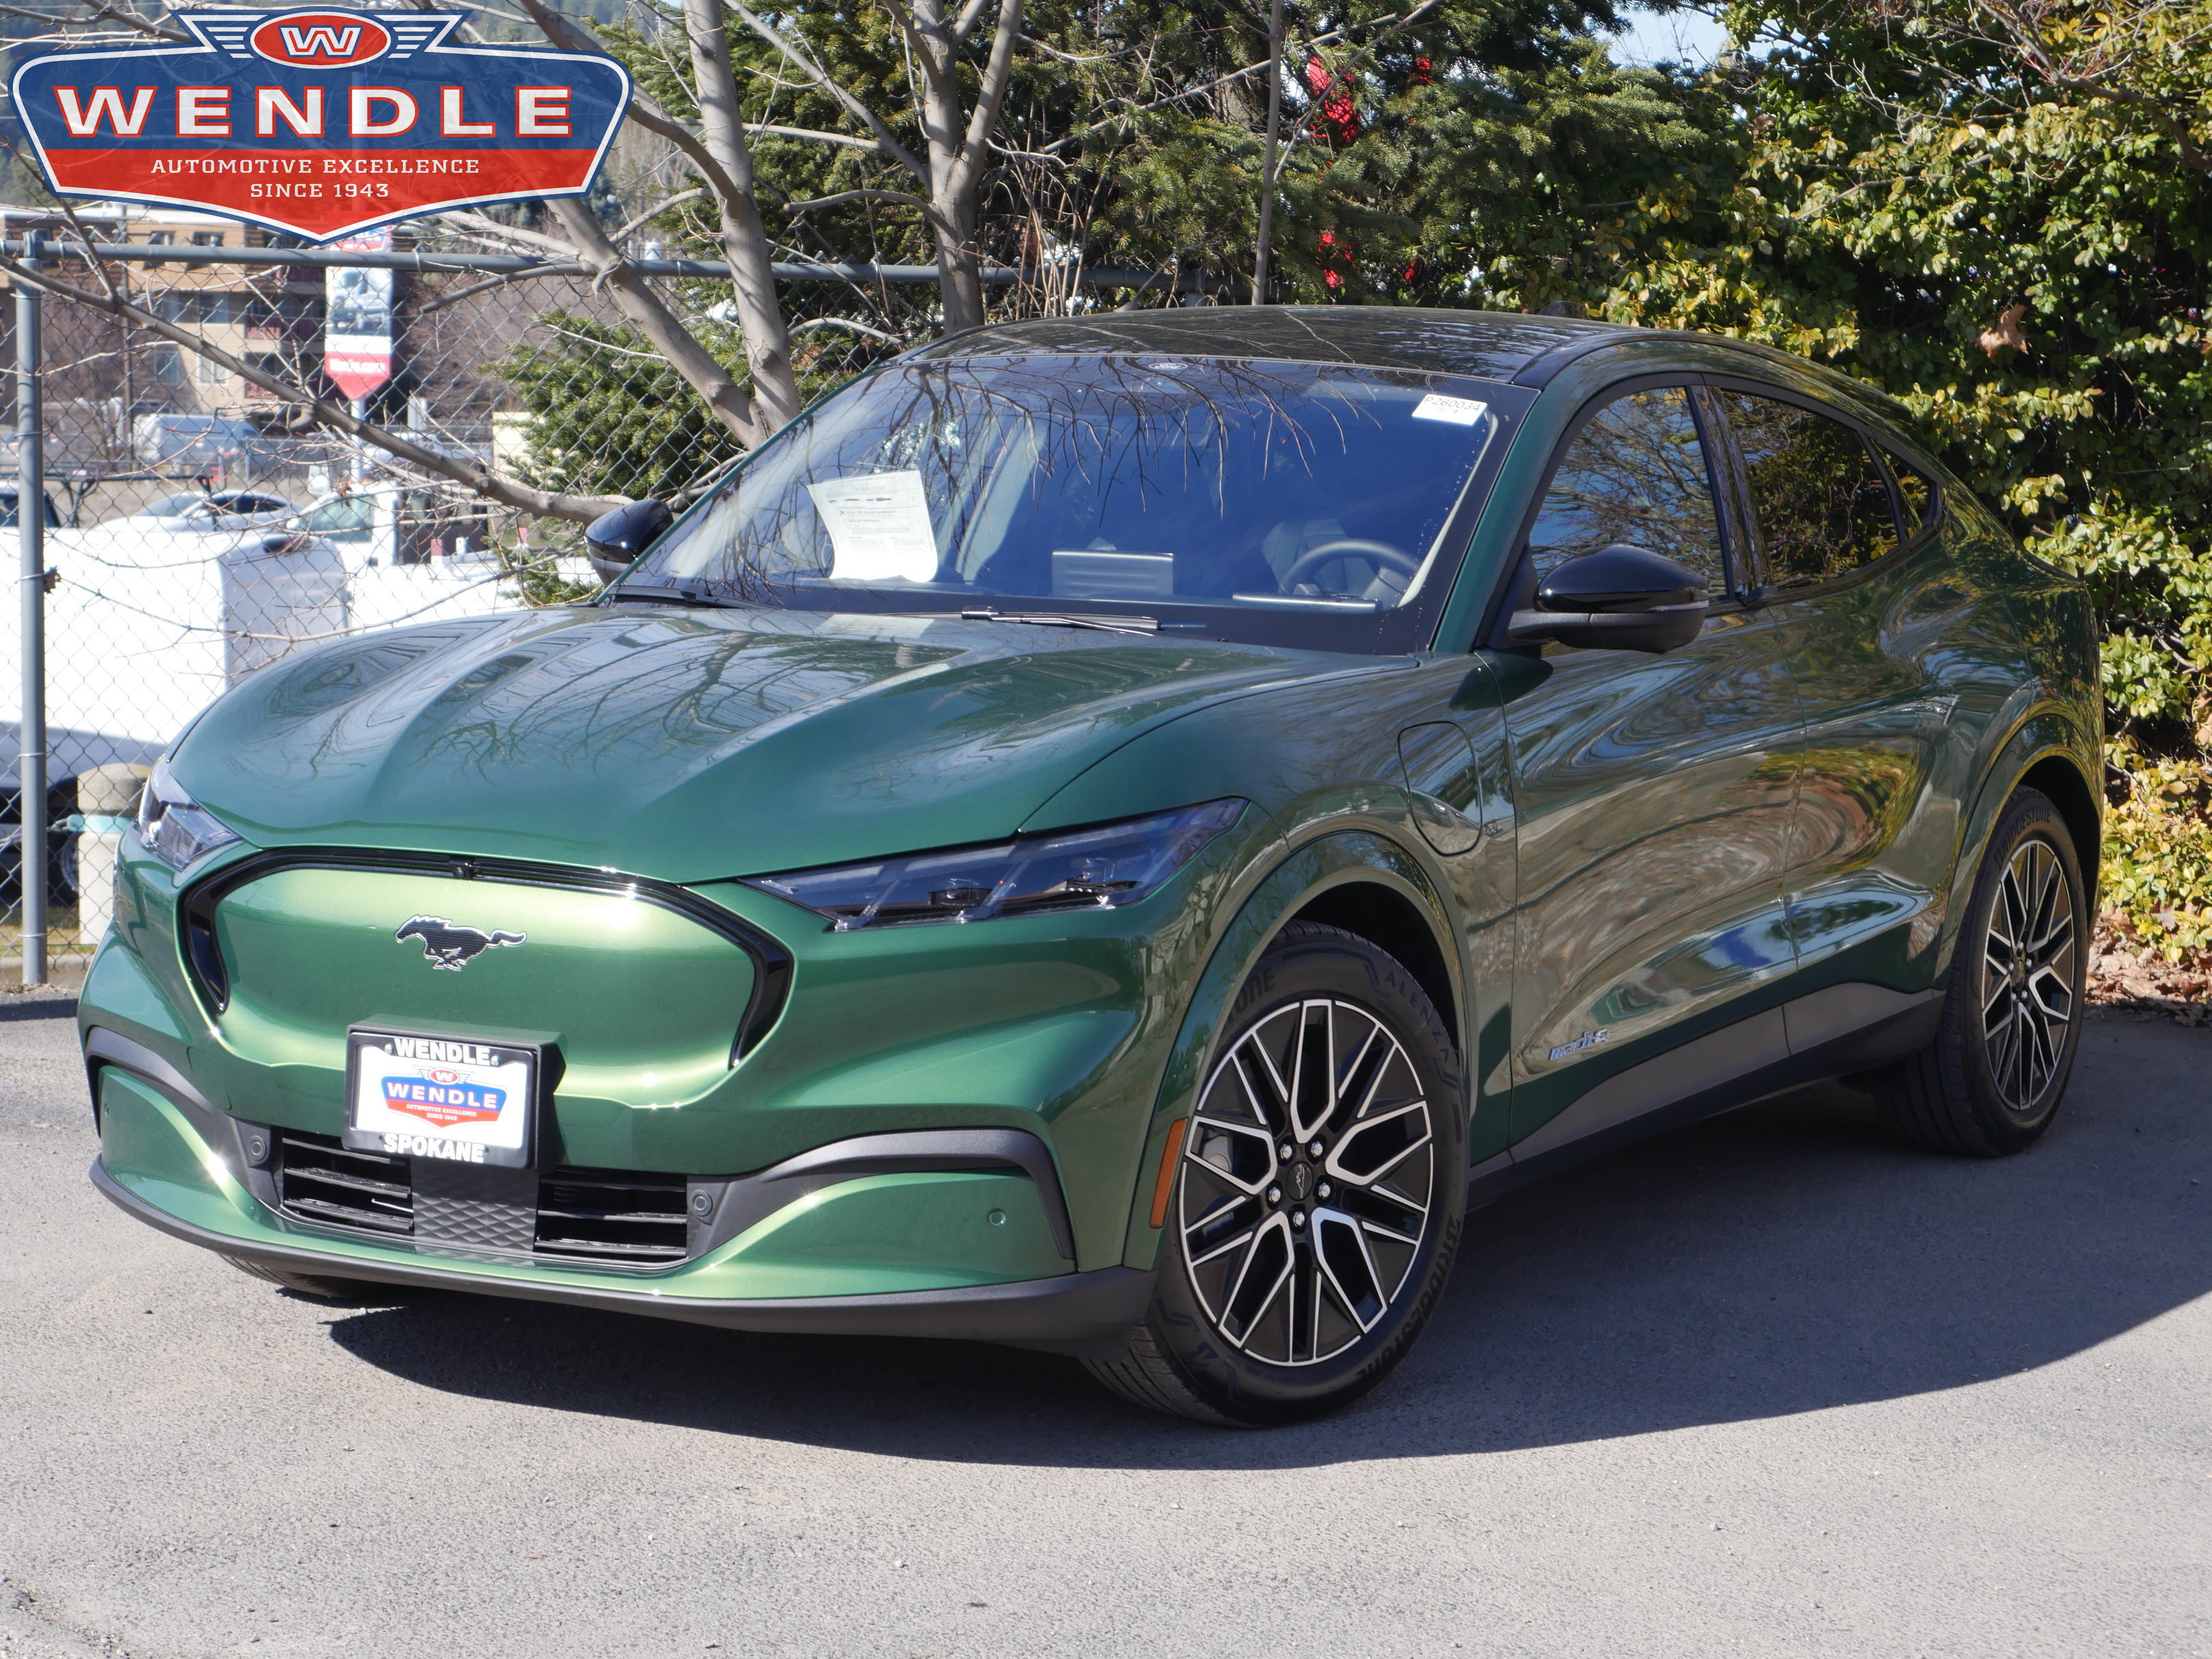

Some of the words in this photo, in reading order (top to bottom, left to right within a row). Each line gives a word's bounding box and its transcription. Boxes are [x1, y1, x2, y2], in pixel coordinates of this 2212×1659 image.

[1424, 396, 1481, 411] P260034
[1385, 970, 1450, 1063] ALENZA
[394, 1037, 491, 1066] WENDLE
[435, 1071, 454, 1082] W
[386, 1081, 498, 1109] WENDLE
[406, 1103, 441, 1113] AUTOMOTIVE
[442, 1107, 477, 1117] EXCELLENCE
[383, 1133, 485, 1163] SPOKANE
